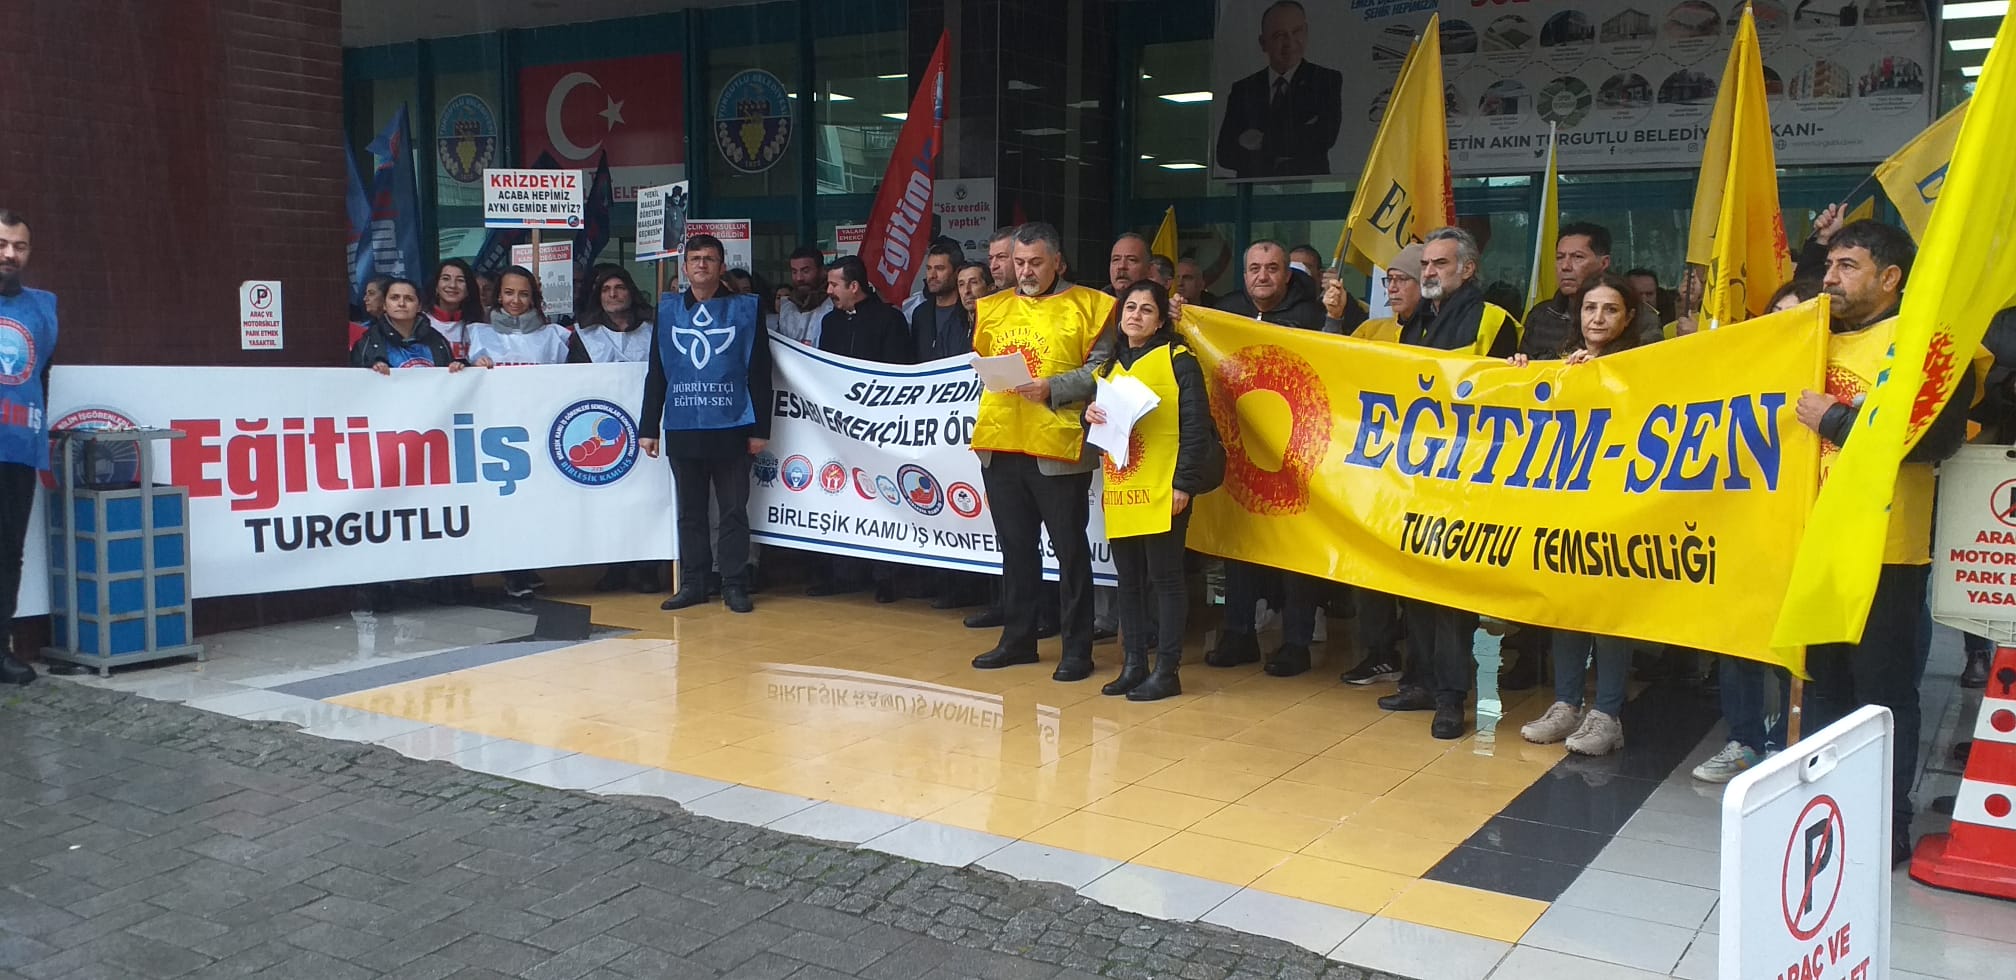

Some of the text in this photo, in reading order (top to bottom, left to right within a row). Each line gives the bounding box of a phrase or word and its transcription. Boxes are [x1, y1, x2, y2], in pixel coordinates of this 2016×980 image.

[1449, 135, 1485, 150] ETİN
[1490, 135, 1531, 148] AKIN
[1634, 124, 1710, 143] BELEDİY
[1771, 121, 1824, 137] KANI-
[490, 171, 576, 188] KRİZDEYİZ
[498, 189, 570, 200] ACABA HEPİMİZ
[488, 202, 581, 213] AYNI GEMİDE MİYİZ?
[957, 201, 990, 213] verdik
[686, 223, 703, 231] ÇLIK
[672, 381, 734, 394] HÜRRİYETÇİ
[844, 379, 925, 407] SİZLER
[674, 394, 733, 407] EĞİTİM-SEN
[773, 390, 977, 448] ESABI EMEKÇİLER ÖD
[1343, 373, 1786, 493] EĞİTİM-SEN
[170, 412, 531, 512] Eğitimiş
[1126, 489, 1151, 505] SEN
[244, 504, 471, 553] TURGUTLU
[767, 503, 850, 535] BİRLEŞİK
[855, 517, 908, 541] KAMU
[1975, 530, 2016, 545] ARA
[1400, 511, 1717, 585] TURGUTLU TEMSİLCİLİĞİ
[1950, 549, 2016, 565] MOTOR
[1955, 569, 2005, 585] PARK
[1966, 590, 2016, 606] YASA
[1827, 921, 1851, 966] VE
